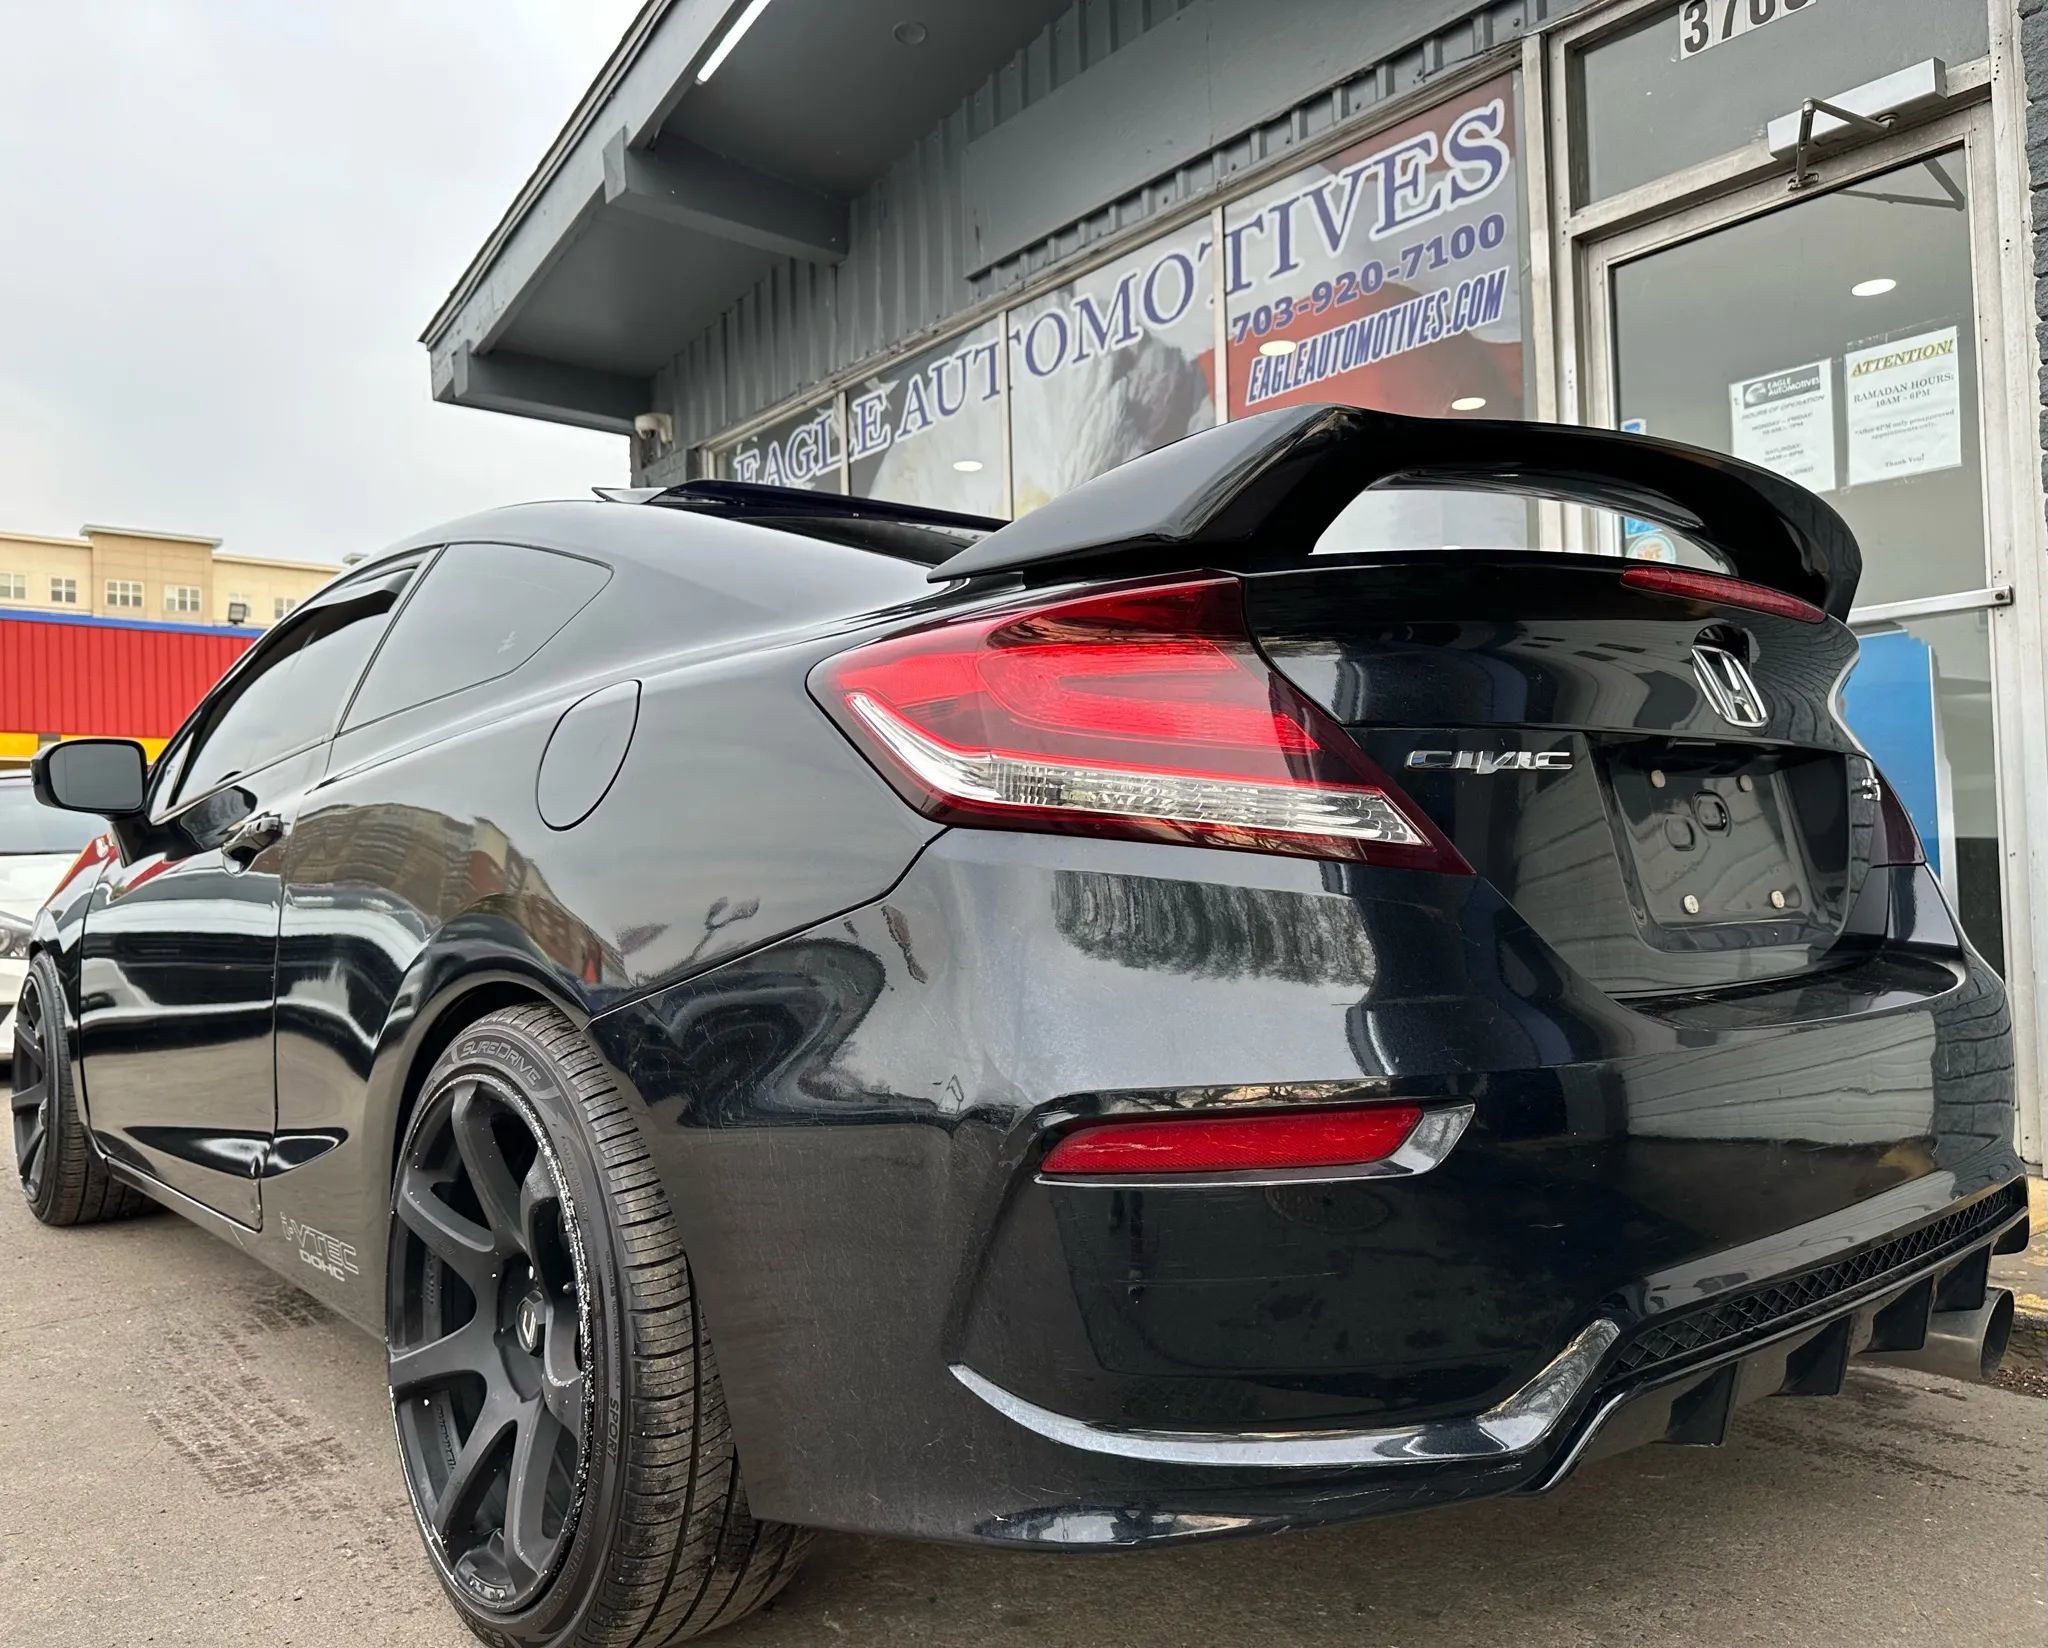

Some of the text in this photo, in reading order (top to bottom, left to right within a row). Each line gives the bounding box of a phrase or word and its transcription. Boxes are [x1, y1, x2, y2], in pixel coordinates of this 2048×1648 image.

[1684, 0, 1810, 53] 37
[735, 98, 1510, 487] EAGLE AUTOMOTIVES
[1232, 212, 1505, 345] 703-920-7100
[1246, 267, 1510, 406] EAGLEAUTOMOTIVES.COM
[1851, 338, 1954, 377] ATTENTION!
[1767, 377, 1791, 390] EAGLE
[1853, 373, 1955, 403] RAMADAN HOURS:
[1876, 394, 1901, 408] 10AM
[1404, 750, 1573, 775] CIVIC
[299, 1248, 345, 1281] DOHC
[606, 1398, 620, 1464] SPORT
